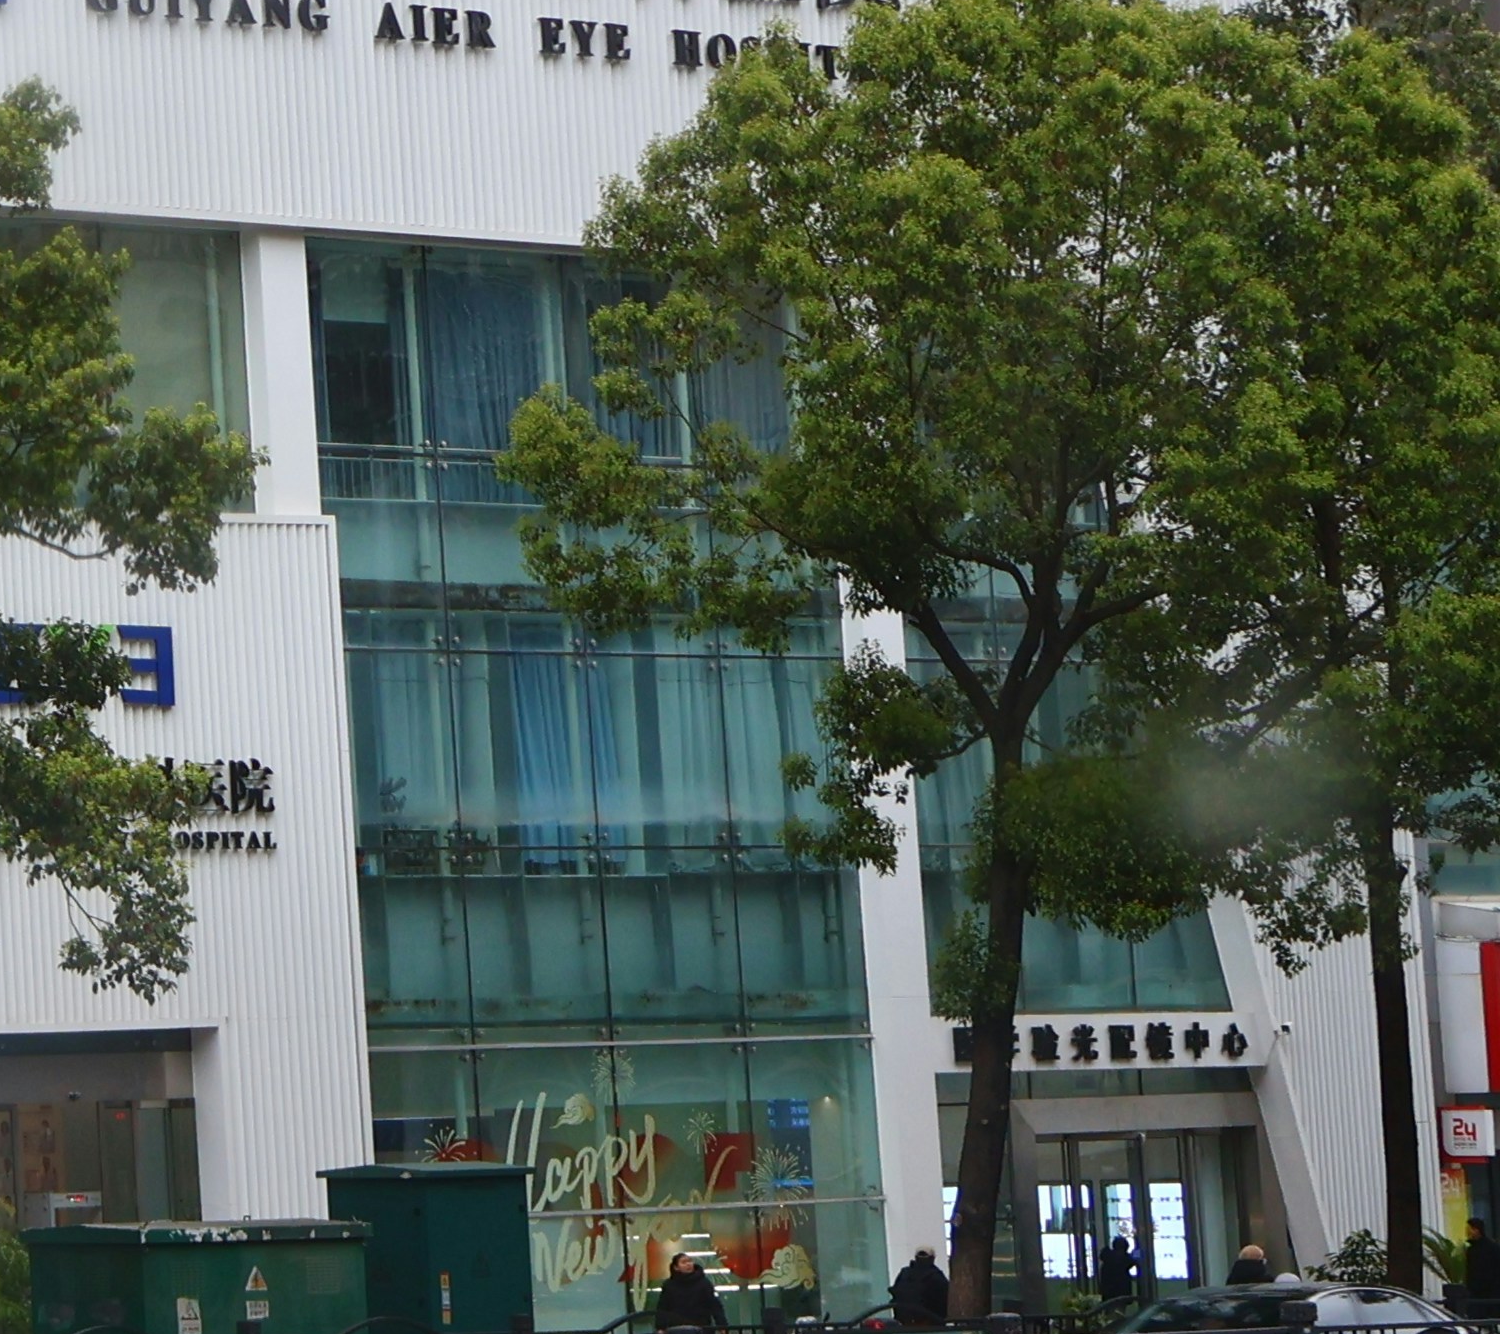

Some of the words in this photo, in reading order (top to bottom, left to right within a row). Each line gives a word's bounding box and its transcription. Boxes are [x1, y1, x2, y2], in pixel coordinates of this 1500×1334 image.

[374, 2, 497, 49] AIER
[538, 17, 631, 61] EYE
[173, 830, 278, 850] OSPITAL
[953, 1021, 1248, 1063] 验光配镜中心
[1452, 1118, 1477, 1141] 24
[507, 1091, 655, 1228] Happy
[532, 1217, 617, 1293] New
